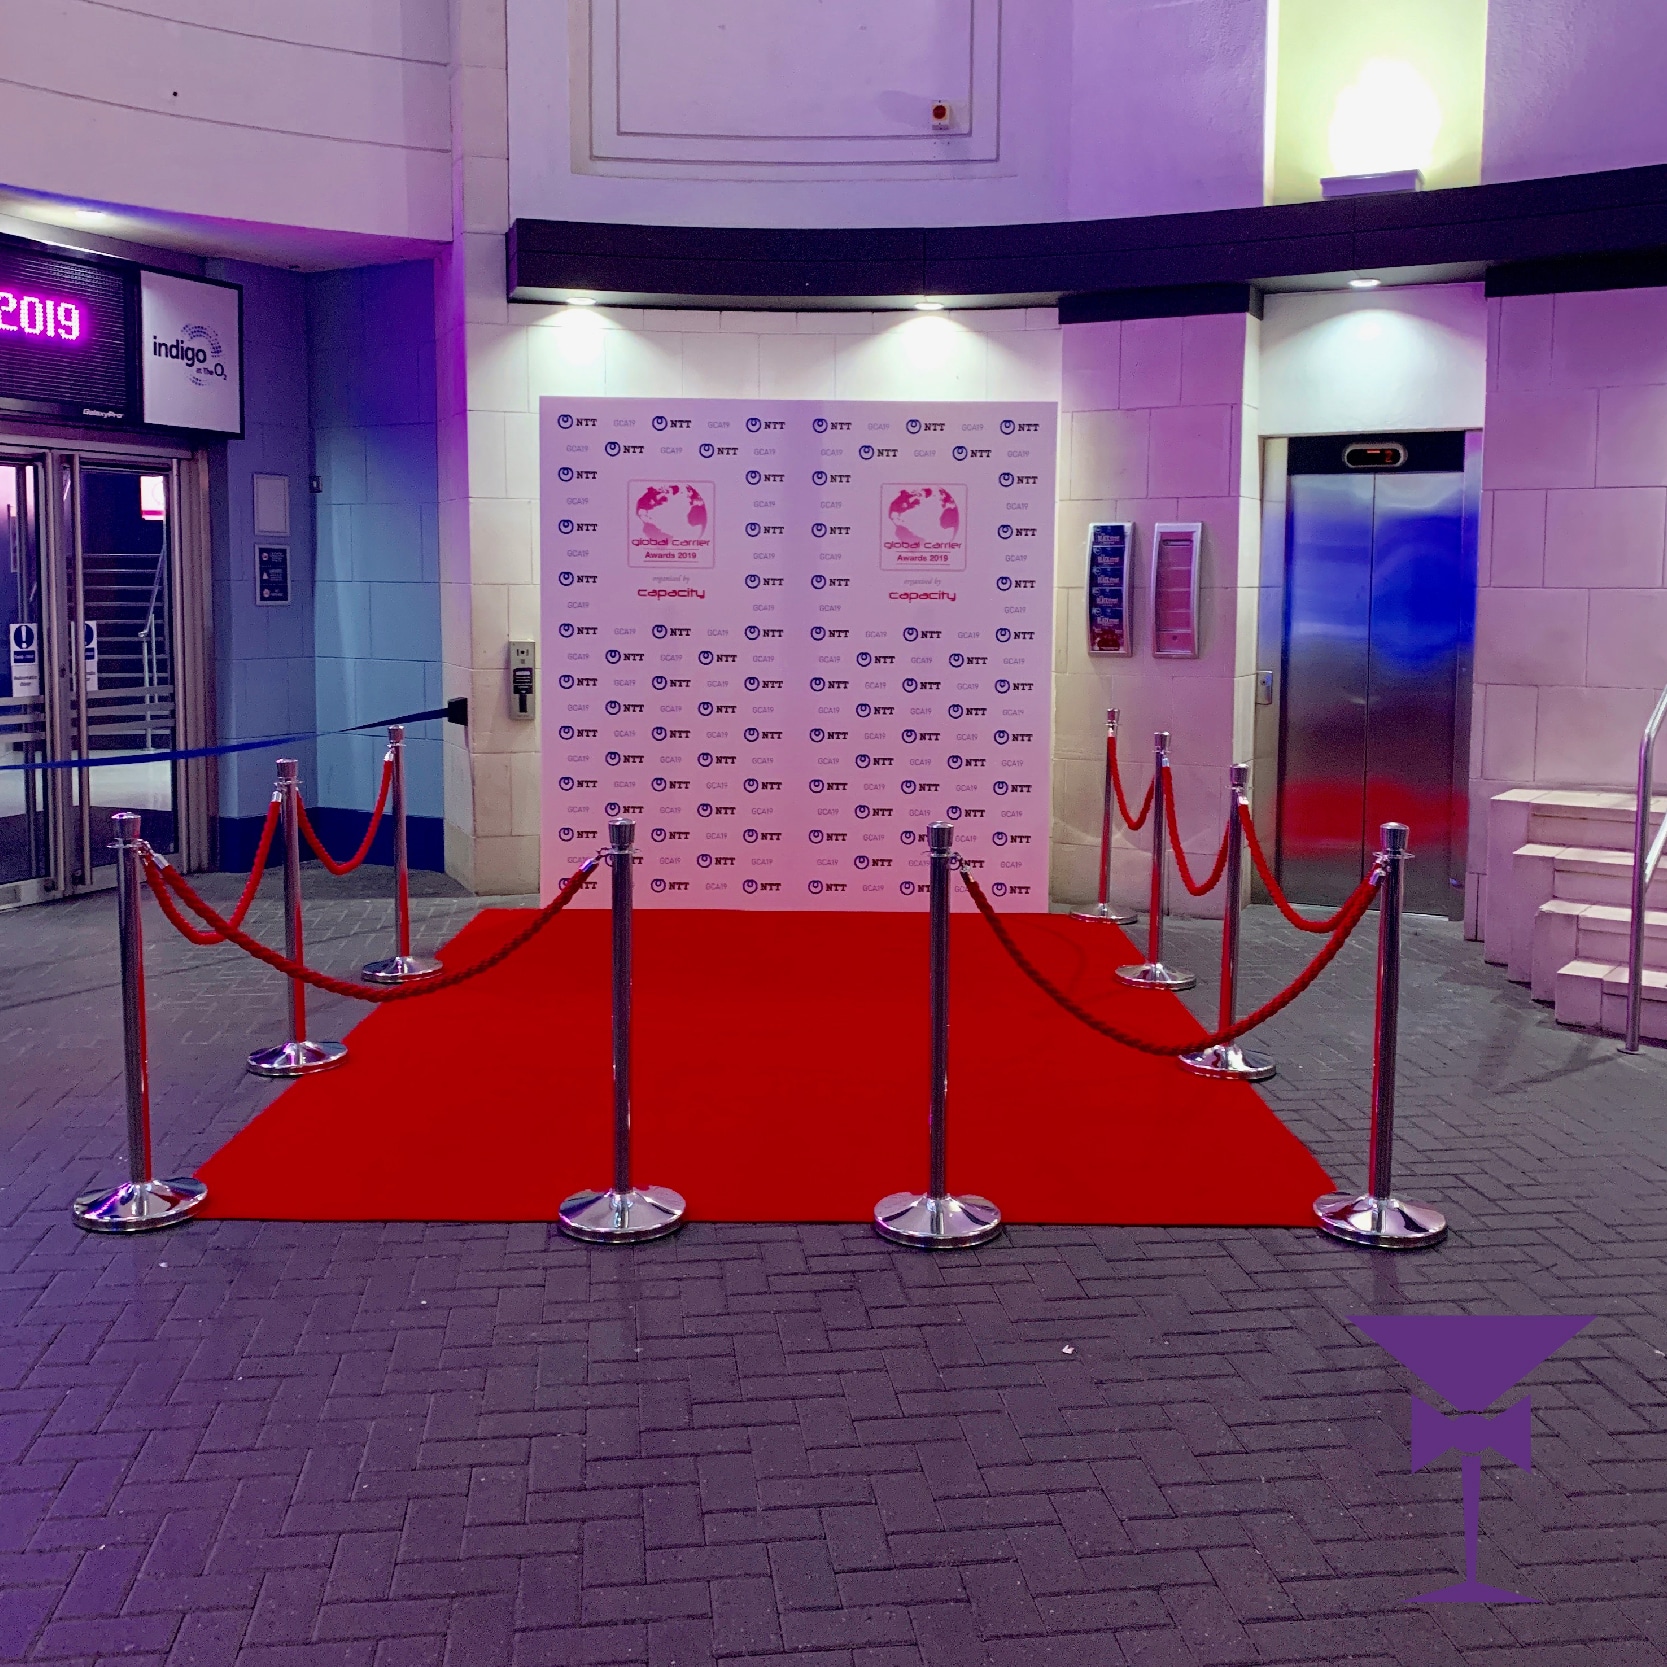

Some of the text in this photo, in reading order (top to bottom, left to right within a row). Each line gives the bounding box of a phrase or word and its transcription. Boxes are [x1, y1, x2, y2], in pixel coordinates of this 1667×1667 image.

[0, 292, 80, 341] 2019
[153, 335, 207, 367] indigo
[575, 417, 598, 427] NTT
[612, 418, 637, 428] GCA19
[669, 419, 693, 429] NTT
[763, 421, 787, 430] NTT
[830, 421, 853, 431] NTT
[867, 422, 890, 431] GCA19
[923, 422, 946, 432] NTT
[961, 423, 985, 432] GCA19
[1017, 422, 1041, 433] NTT
[565, 444, 589, 453] GCA19
[622, 444, 645, 455] NTT
[716, 446, 739, 456] NTT
[753, 447, 776, 456] GCA19
[820, 448, 844, 457] GCA19
[876, 448, 899, 458] NTT
[913, 449, 937, 458] GCA19
[969, 449, 993, 459] NTT
[575, 470, 598, 480] NTT
[763, 473, 786, 483] NTT
[829, 474, 852, 484] NTT
[1015, 475, 1039, 485] NTT
[565, 496, 589, 506] GCA19
[753, 500, 776, 508] GCA19
[1005, 502, 1029, 511] GCA19
[576, 522, 598, 532] NTT
[763, 525, 785, 535] NTT
[829, 526, 852, 535] NTT
[1014, 527, 1038, 537] NTT
[631, 538, 669, 546] global
[883, 541, 920, 549] global
[566, 549, 590, 558] GCA19
[644, 551, 697, 559] Awards 2019
[752, 552, 776, 560] GCA19
[896, 554, 949, 562] Awards 2019
[1004, 554, 1028, 563] GCA19
[576, 574, 598, 584] NTT
[762, 577, 785, 587] NTT
[828, 578, 851, 587] NTT
[1013, 579, 1037, 589] NTT
[637, 588, 706, 601] capacity
[888, 590, 957, 603] capacity
[566, 601, 590, 609] GCA19
[818, 604, 842, 612] GCA19
[1003, 605, 1027, 615] GCA19
[576, 626, 599, 636] NTT
[669, 627, 692, 637] NTT
[706, 626, 729, 637] GCA19
[761, 628, 785, 638] NTT
[827, 629, 850, 639] NTT
[864, 630, 888, 639] GCA19
[919, 630, 943, 639] NTT
[956, 631, 981, 639] GCA19
[1013, 631, 1036, 641] NTT
[567, 652, 591, 661] GCA19
[622, 652, 645, 662] NTT
[715, 653, 738, 663] NTT
[752, 654, 775, 663] GCA19
[818, 655, 841, 664] GCA19
[873, 655, 896, 665] NTT
[966, 656, 989, 665] NTT
[1002, 657, 1026, 665] GCA19
[576, 677, 599, 687] NTT
[613, 679, 637, 687] GCA19
[669, 679, 692, 688] NTT
[706, 680, 729, 688] GCA19
[761, 679, 784, 689] NTT
[827, 680, 850, 690] NTT
[919, 681, 942, 691] NTT
[955, 682, 980, 691] GCA19
[1012, 682, 1035, 691] NTT
[567, 703, 591, 712] GCA19
[622, 703, 645, 713] NTT
[715, 705, 738, 714] NTT
[751, 706, 775, 714] GCA19
[817, 706, 841, 714] GCA19
[873, 706, 896, 716] NTT
[909, 707, 933, 716] GCA19
[965, 707, 988, 717] NTT
[576, 728, 599, 738] NTT
[613, 729, 637, 738] GCA19
[668, 729, 692, 739] NTT
[705, 731, 729, 739] GCA19
[761, 731, 784, 740] NTT
[826, 731, 849, 740] NTT
[863, 731, 887, 740] GCA19
[918, 732, 941, 742] NTT
[1010, 733, 1034, 743] NTT
[566, 754, 593, 763] GCA19
[622, 754, 645, 764] NTT
[659, 754, 683, 764] GCA19
[715, 755, 737, 765] NTT
[817, 757, 840, 766] GCA19
[872, 757, 895, 766] NTT
[964, 758, 987, 768] NTT
[1000, 759, 1025, 768] GCA19
[575, 779, 599, 789] NTT
[668, 780, 691, 790] NTT
[705, 781, 729, 790] GCA19
[760, 781, 783, 791] NTT
[826, 781, 849, 791] NTT
[863, 782, 886, 791] GCA19
[918, 782, 941, 792] NTT
[1010, 784, 1033, 794] NTT
[566, 805, 591, 816] GCA19
[622, 805, 645, 814] NTT
[659, 806, 682, 815] GCA19
[714, 806, 737, 816] NTT
[750, 807, 774, 816] GCA19
[871, 807, 894, 817] NTT
[964, 808, 986, 818] NTT
[1000, 810, 1024, 818] GCA19
[575, 830, 599, 839] NTT
[668, 830, 691, 840] NTT
[705, 832, 728, 840] GCA19
[760, 832, 783, 842] NTT
[825, 832, 848, 842] NTT
[954, 835, 977, 843] GCA19
[1009, 834, 1032, 844] NTT
[659, 856, 682, 865] GCA19
[713, 856, 737, 866] NTT
[816, 858, 839, 866] GCA19
[871, 858, 894, 867] NTT
[999, 860, 1023, 869] GCA19
[668, 881, 691, 891] NTT
[759, 882, 783, 892] NTT
[825, 882, 848, 892] NTT
[861, 884, 885, 892] GCA19
[1008, 885, 1032, 895] NTT
